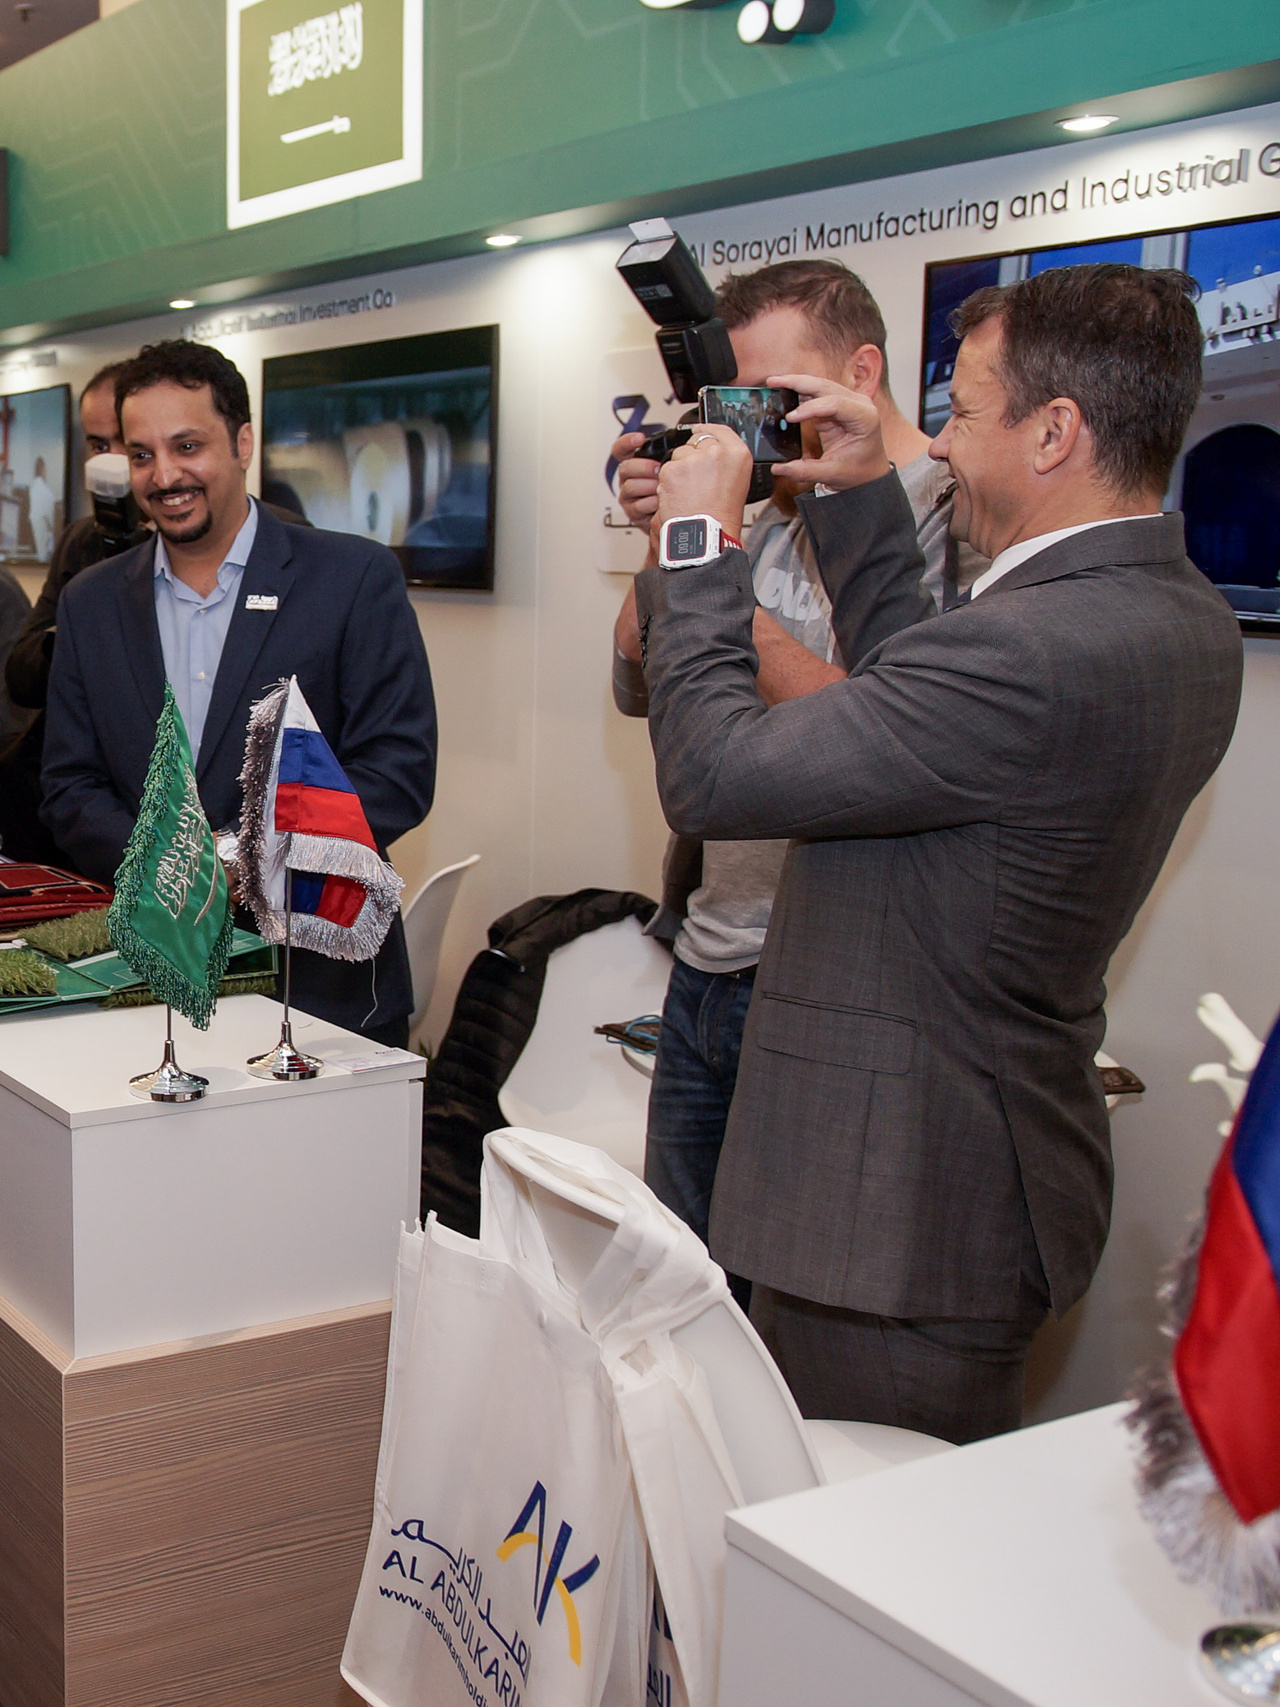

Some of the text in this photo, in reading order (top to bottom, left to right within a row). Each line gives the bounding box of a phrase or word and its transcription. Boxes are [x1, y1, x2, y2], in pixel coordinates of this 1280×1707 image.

[712, 227, 798, 267] Sorayai
[806, 198, 999, 252] Manufacturing
[1010, 180, 1070, 219] and
[1082, 148, 1248, 209] Industrial
[381, 1549, 424, 1585] AL
